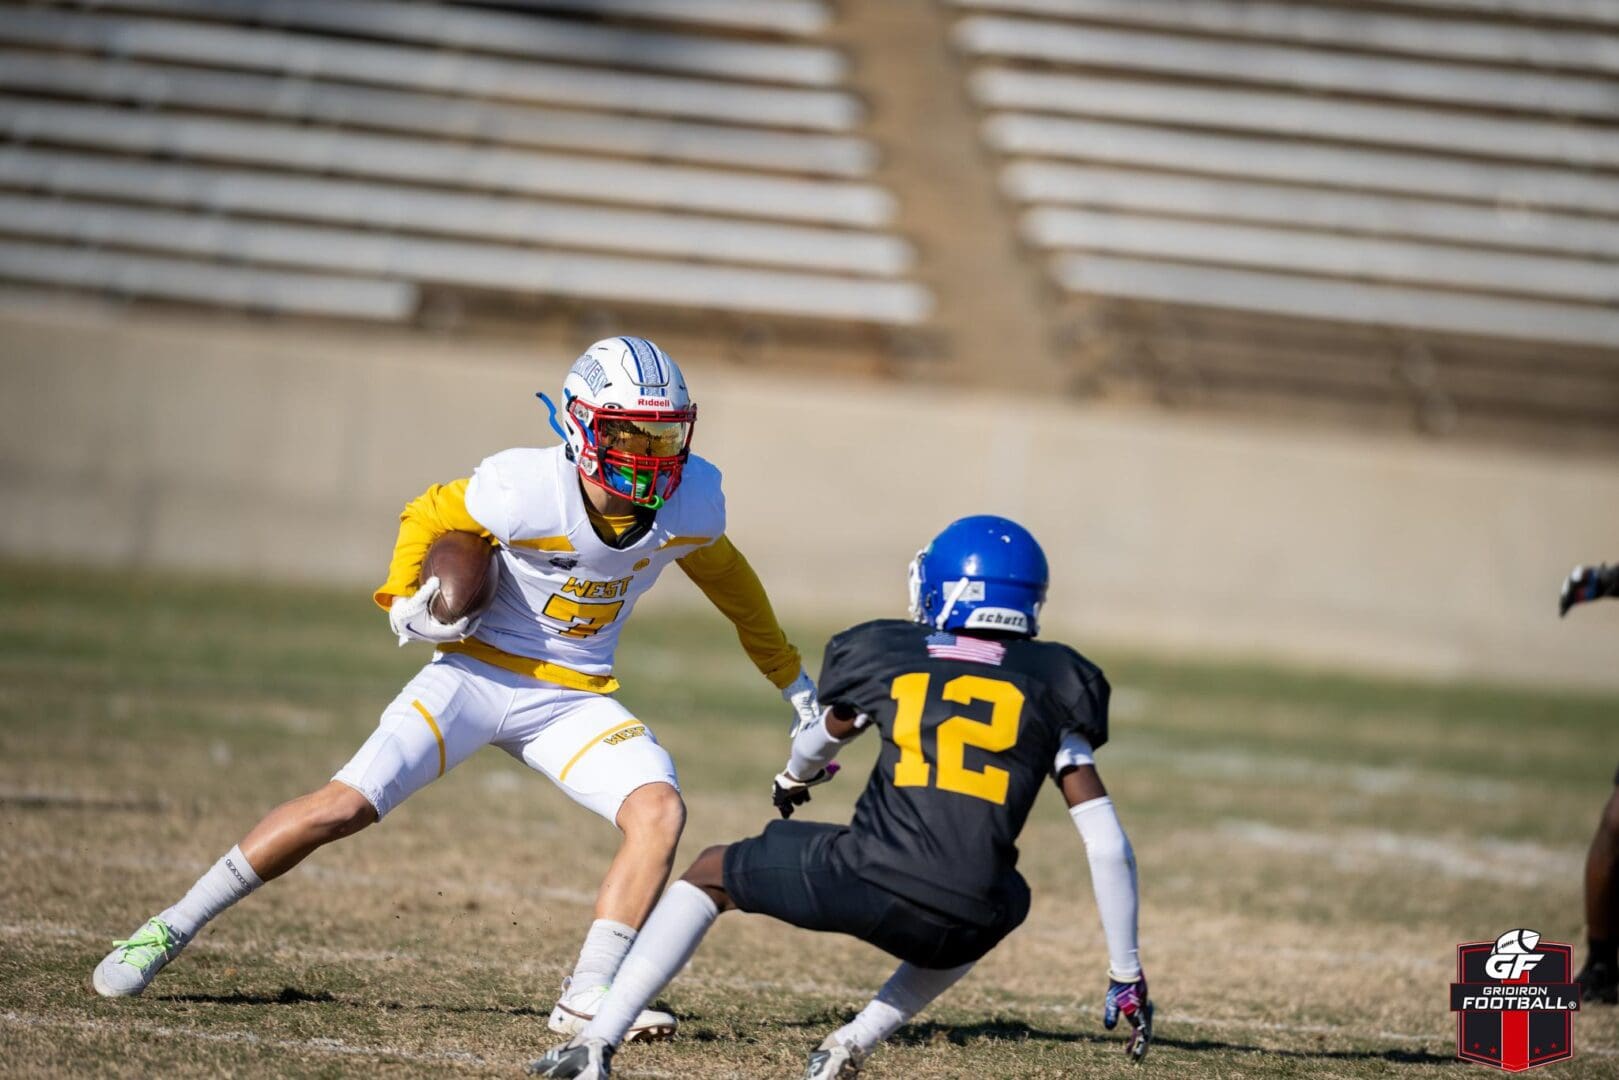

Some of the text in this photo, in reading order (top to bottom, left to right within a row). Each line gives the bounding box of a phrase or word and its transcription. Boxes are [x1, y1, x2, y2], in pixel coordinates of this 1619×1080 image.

[561, 575, 634, 598] WEST
[977, 612, 1024, 626] schutt
[603, 726, 645, 746] WEST
[890, 672, 1025, 805] 12
